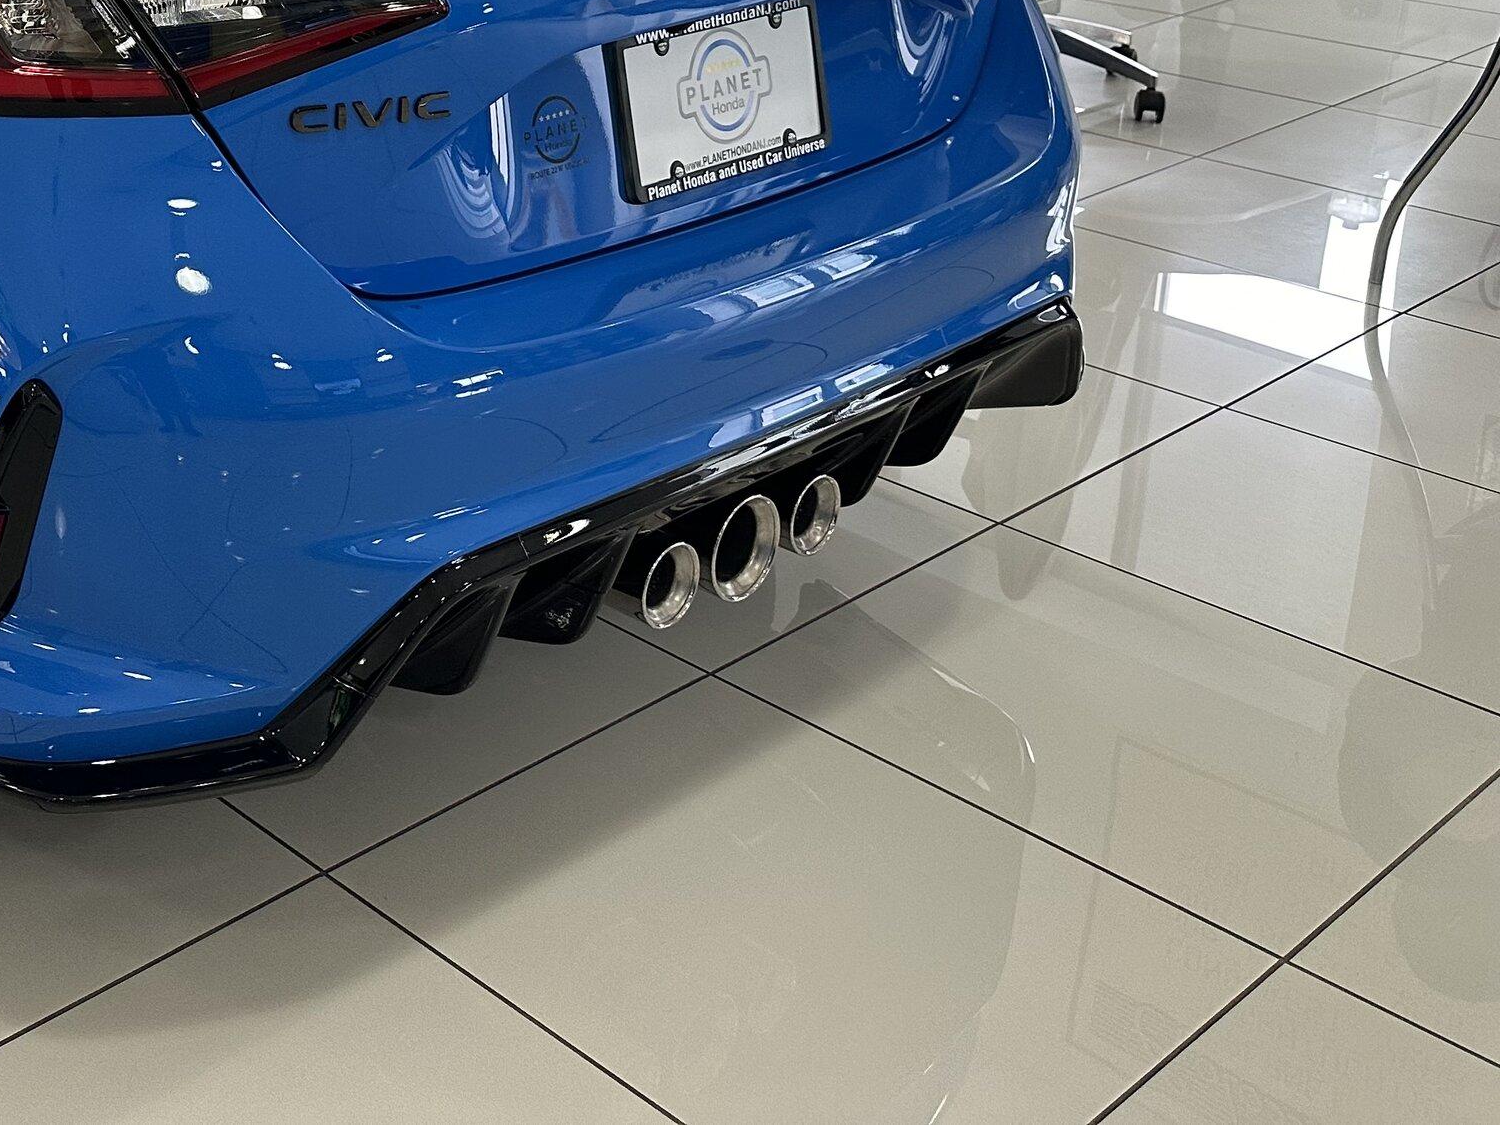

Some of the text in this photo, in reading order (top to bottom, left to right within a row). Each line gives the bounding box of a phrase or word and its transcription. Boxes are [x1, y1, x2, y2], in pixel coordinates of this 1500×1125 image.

[686, 68, 763, 106] PLANET
[288, 90, 451, 134] CIVIC
[712, 96, 746, 116] Honda
[523, 116, 588, 145] PLANET
[647, 138, 826, 201] Planet Honda and Used Car Universe
[685, 135, 782, 172] www.PLANETHONDANJ.com
